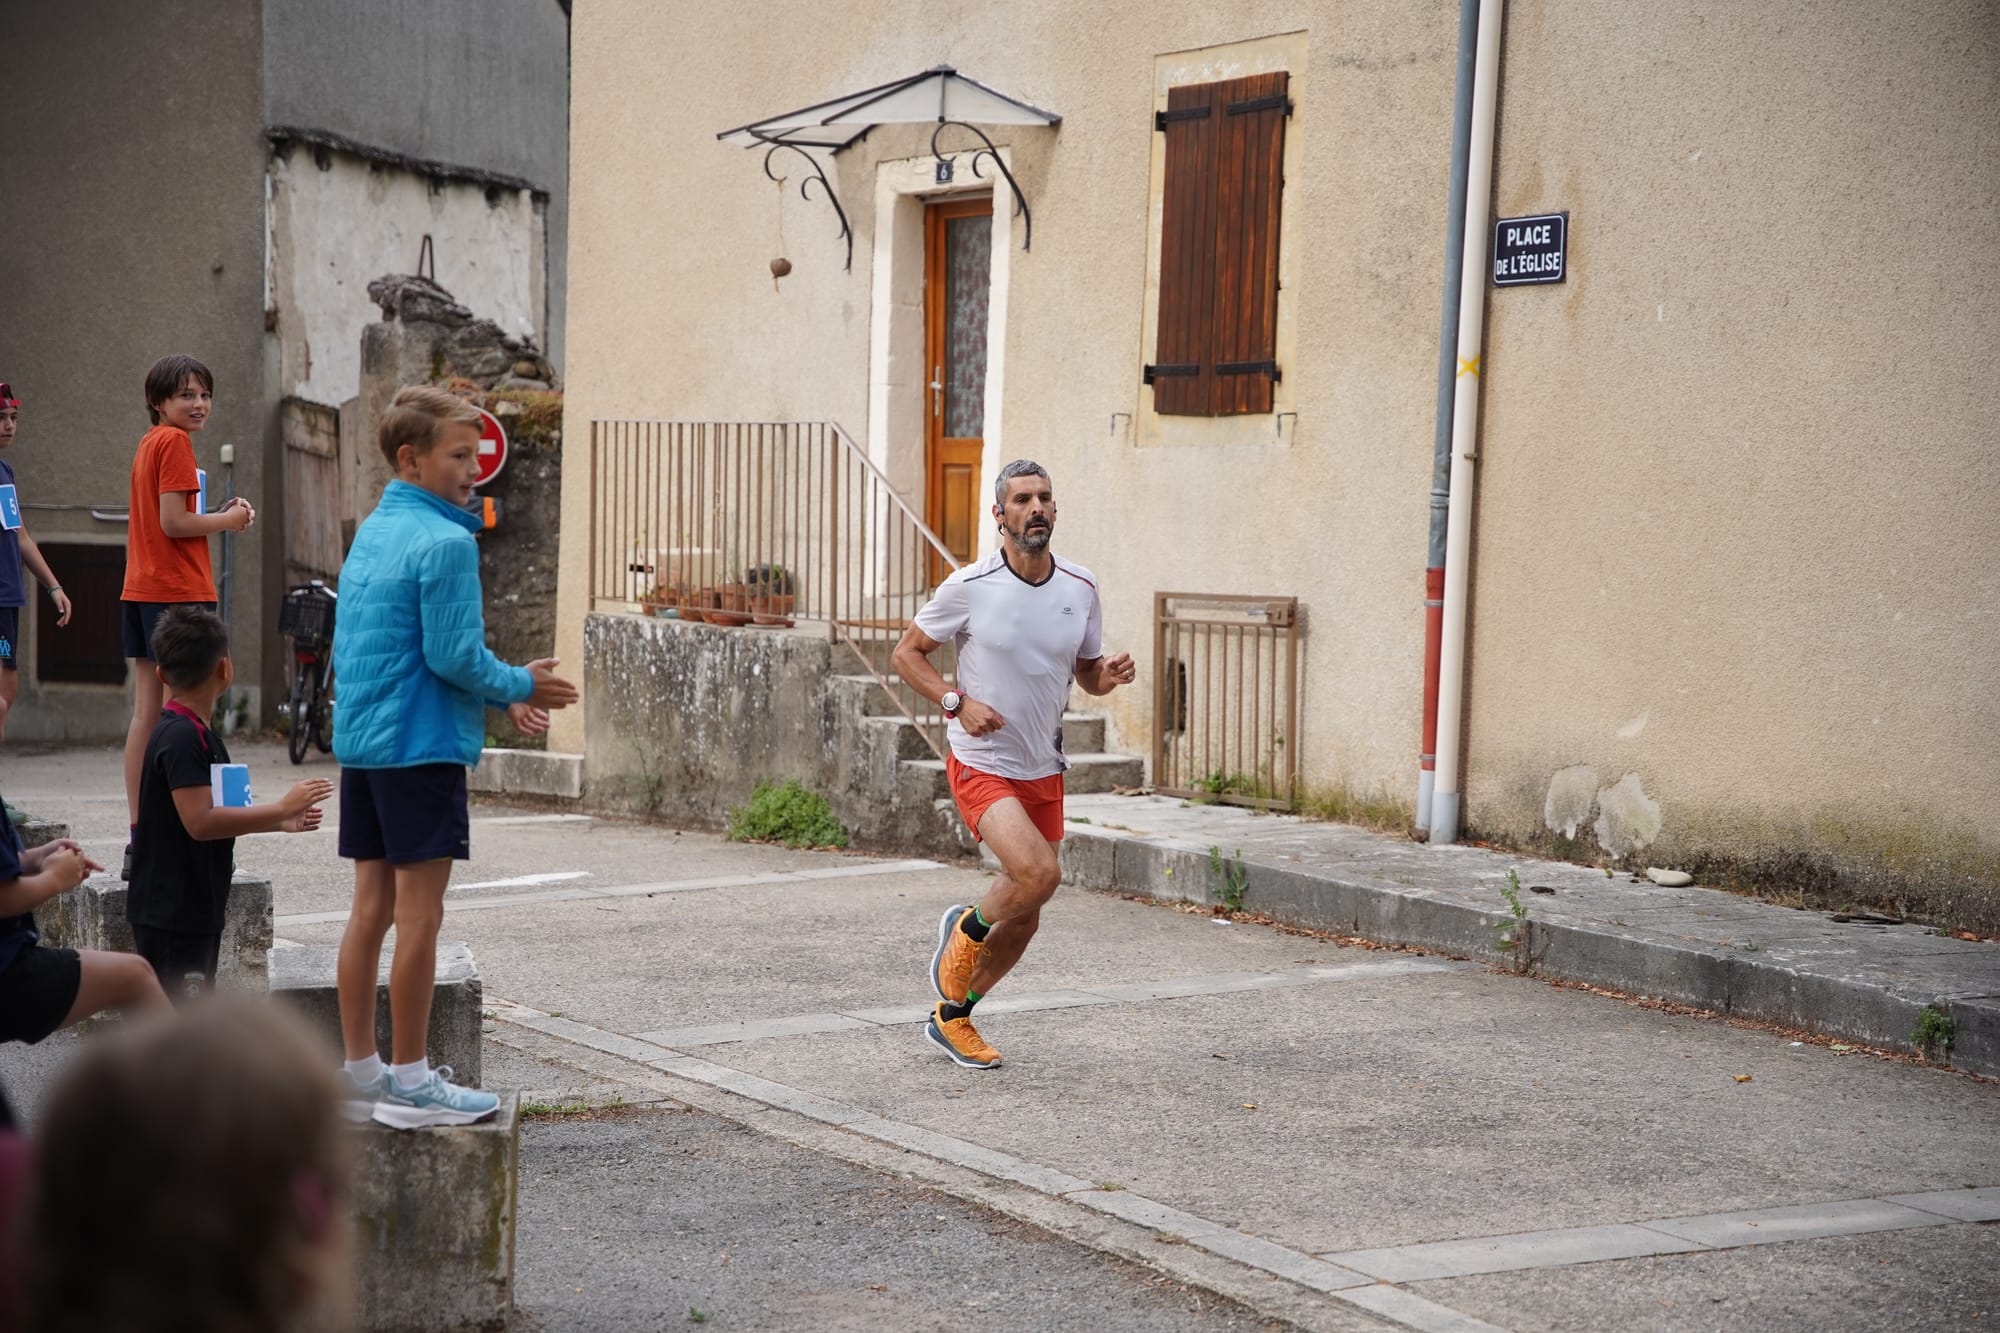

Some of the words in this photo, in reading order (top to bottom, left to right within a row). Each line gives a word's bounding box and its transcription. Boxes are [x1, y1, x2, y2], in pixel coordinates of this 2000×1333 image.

[940, 164, 948, 180] 6
[1507, 225, 1551, 247] PLACE
[1496, 259, 1508, 275] DE
[1510, 251, 1560, 274] L'ÉGLISE
[9, 498, 17, 515] 5
[244, 784, 253, 807] 3
